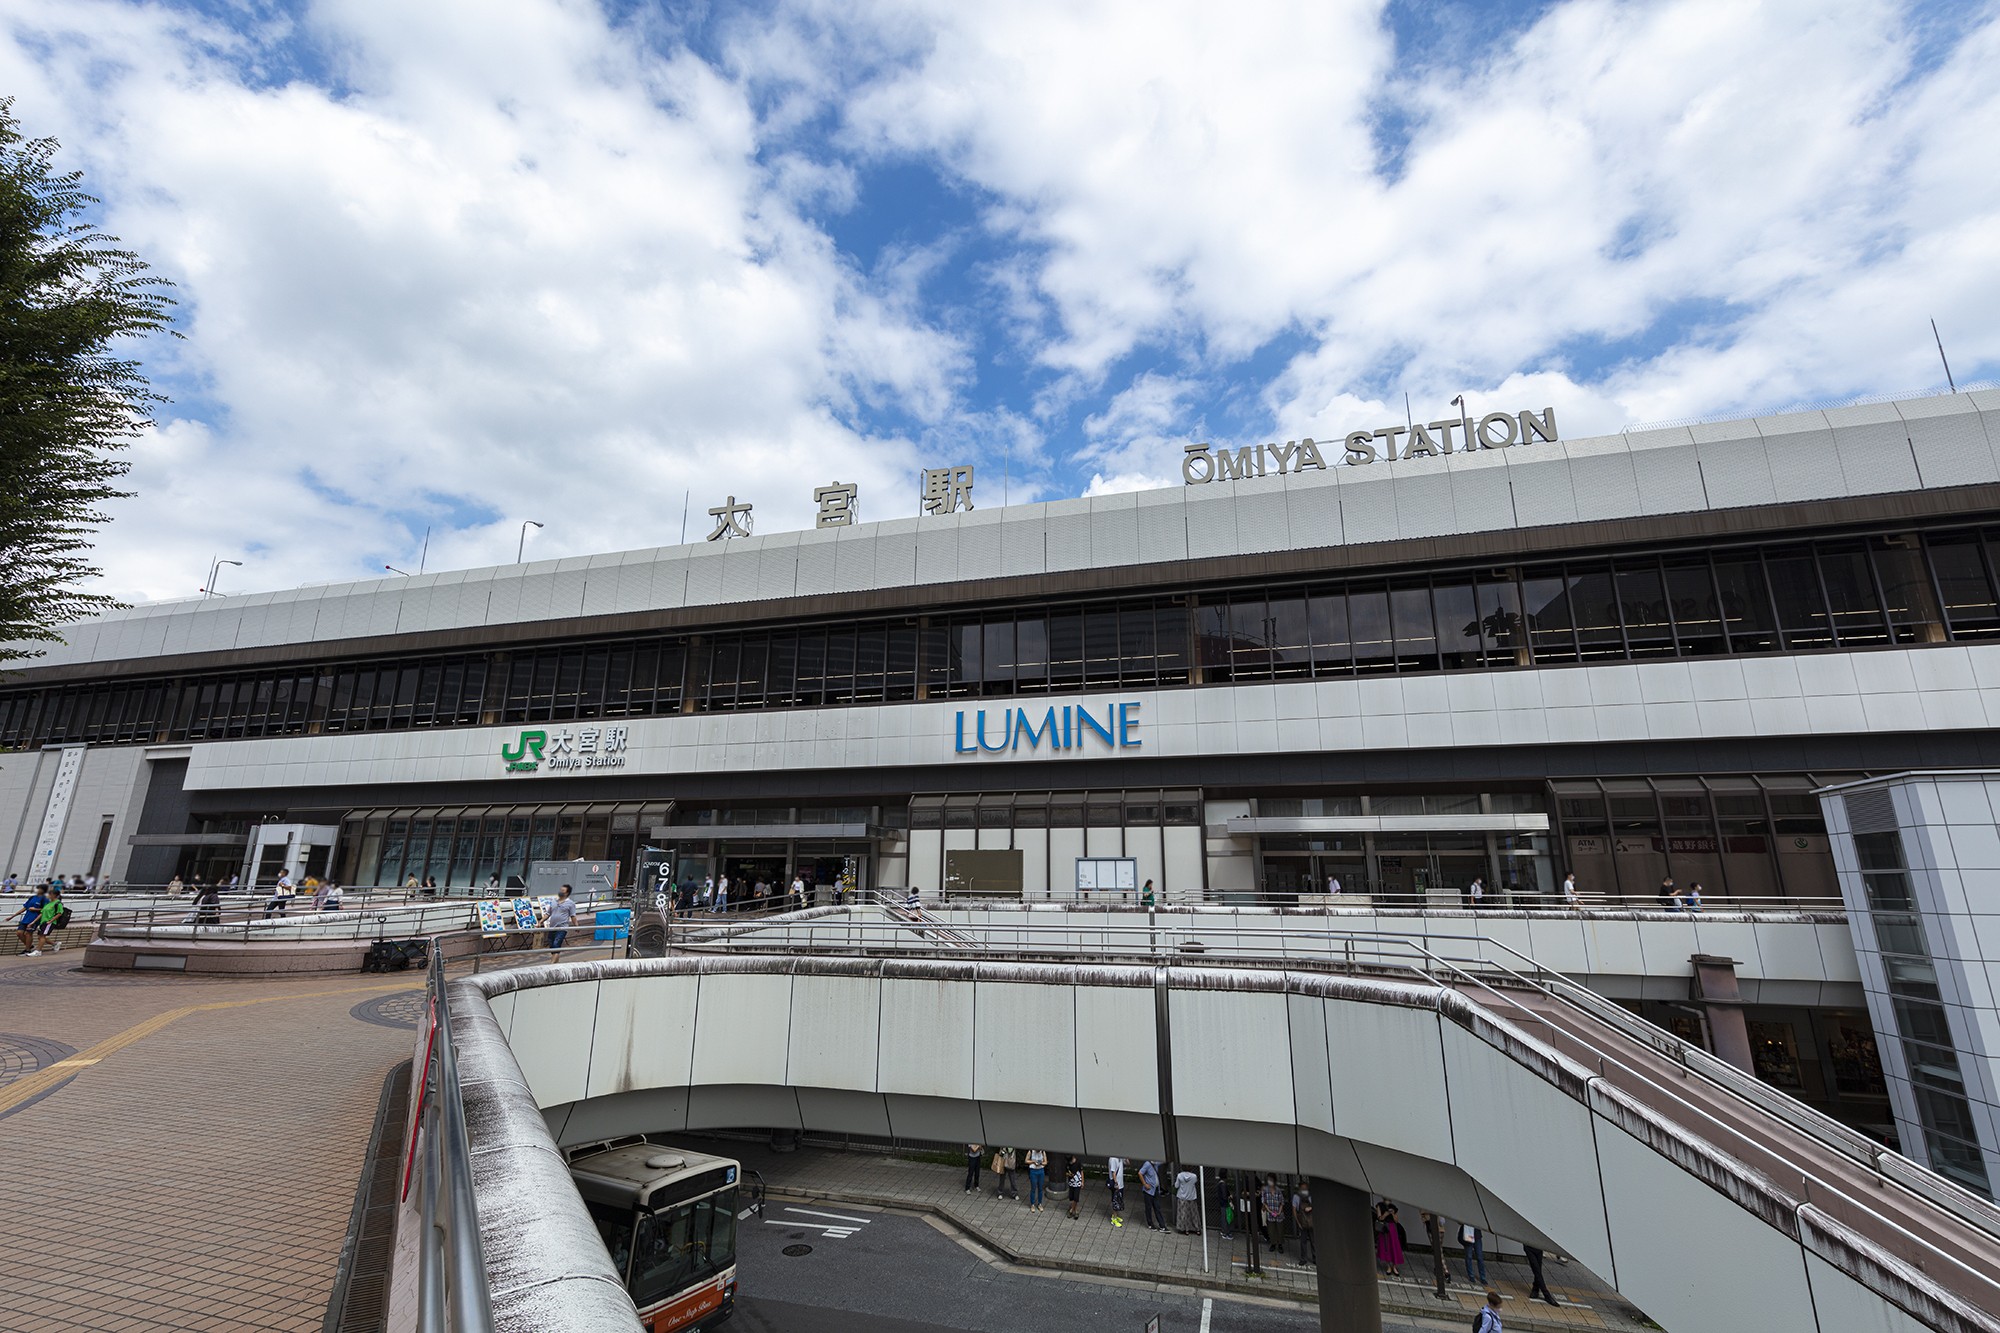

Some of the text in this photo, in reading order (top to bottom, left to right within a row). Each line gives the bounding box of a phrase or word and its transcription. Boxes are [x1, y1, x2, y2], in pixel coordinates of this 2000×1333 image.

[1344, 407, 1558, 467] STATION
[707, 465, 974, 542] 大宮駅
[955, 702, 1142, 753] LUMINE
[502, 730, 546, 761] JR
[550, 727, 628, 754] 大宮駅
[585, 755, 625, 768] Station
[1577, 839, 1596, 847] ATM
[659, 862, 670, 876] 6
[658, 877, 668, 891] 7
[655, 893, 667, 907] 8
